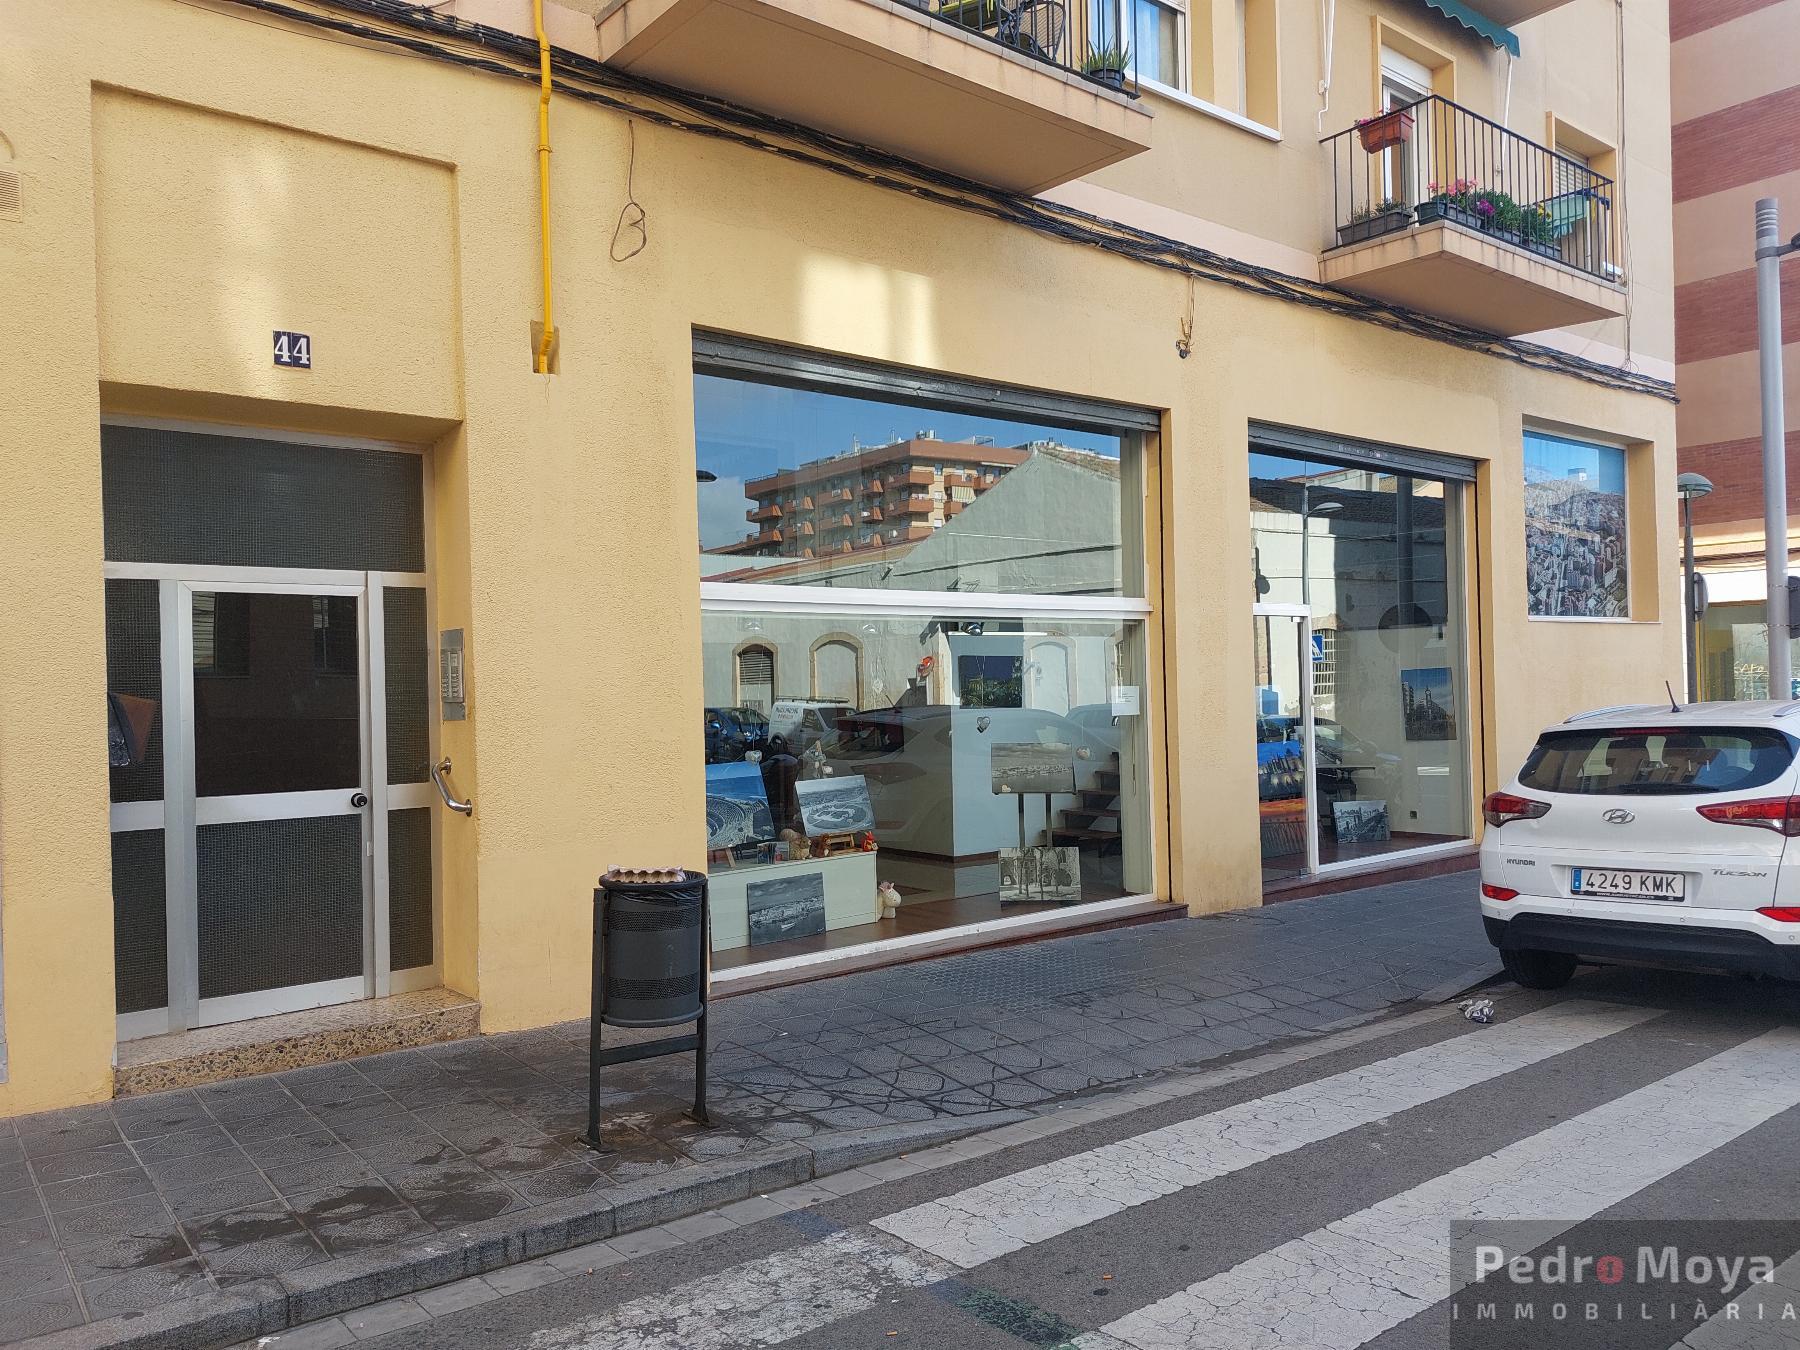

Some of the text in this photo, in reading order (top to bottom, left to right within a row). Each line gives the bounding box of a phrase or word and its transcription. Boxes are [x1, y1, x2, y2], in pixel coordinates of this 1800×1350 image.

[274, 335, 310, 365] 44
[1506, 858, 1536, 866] HYUNDAI
[1711, 868, 1768, 878] TUCSON
[1585, 872, 1677, 894] 4249 KMK
